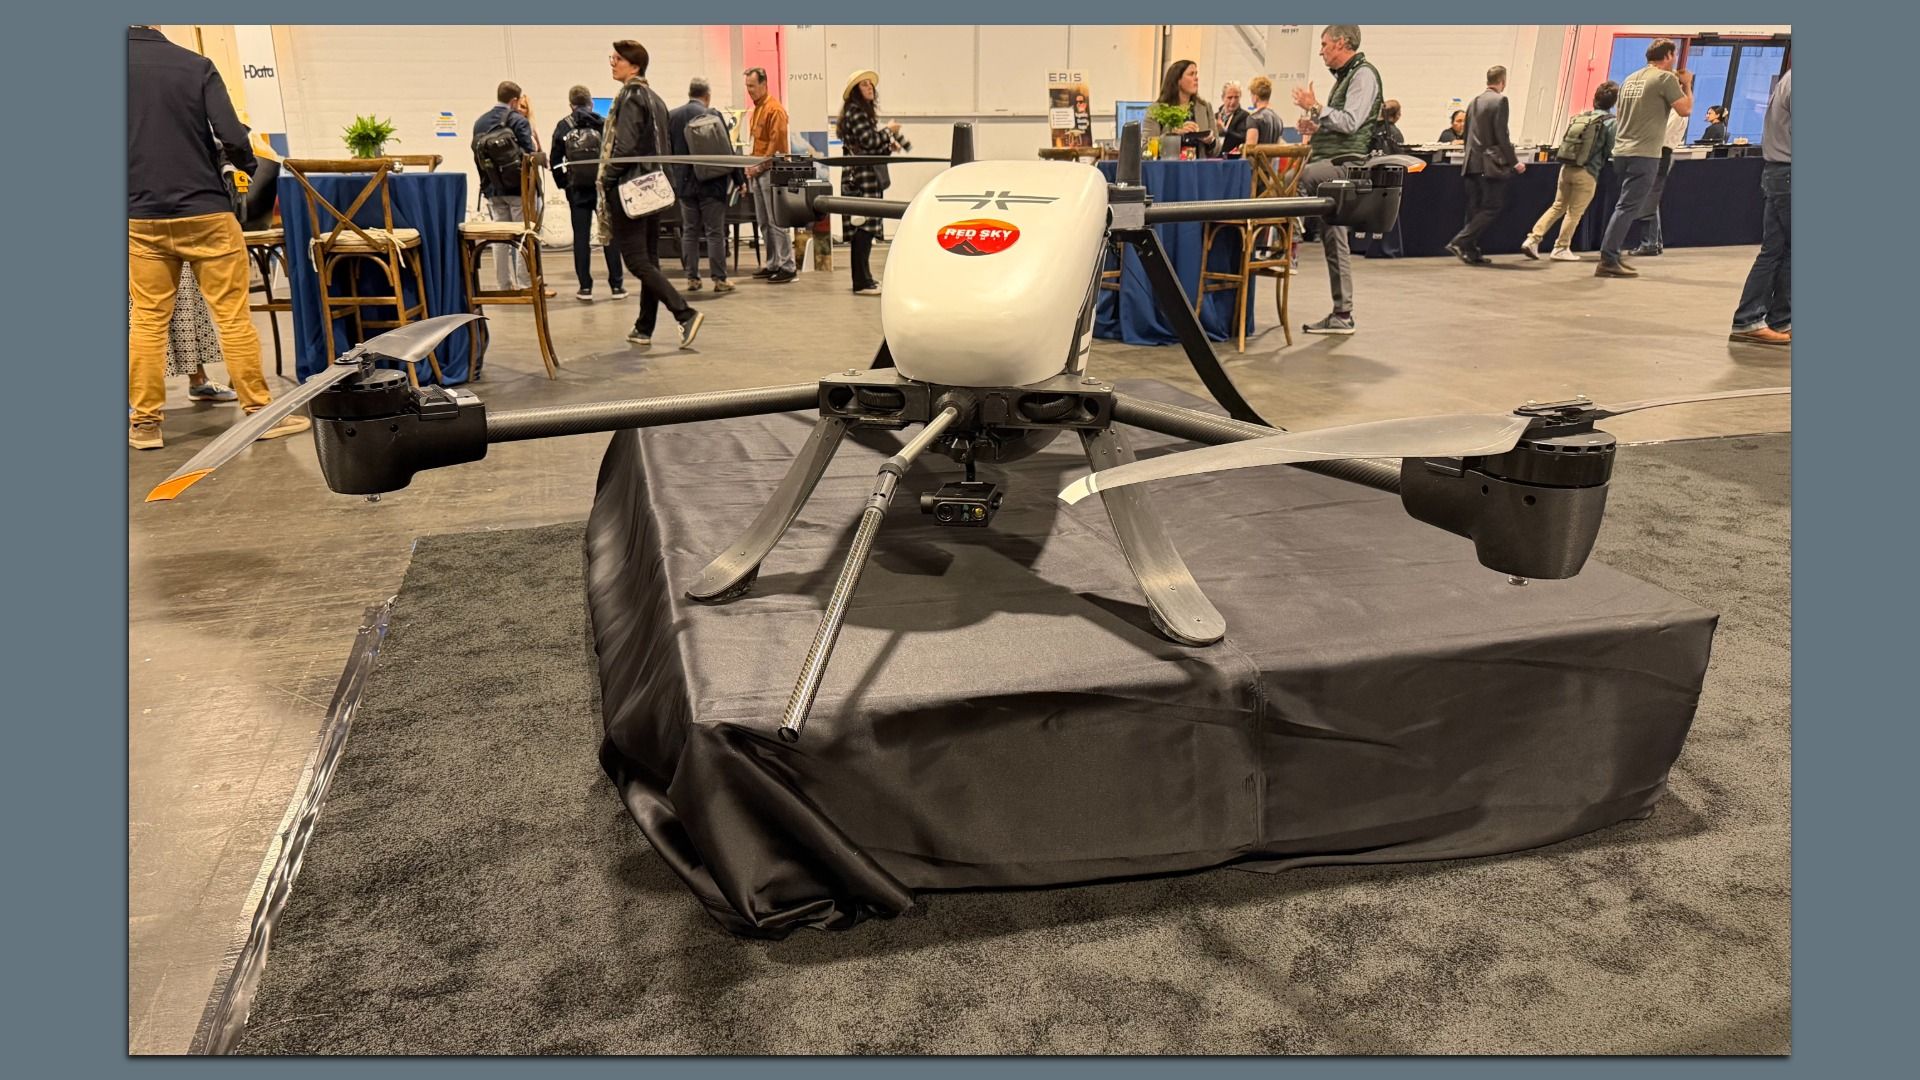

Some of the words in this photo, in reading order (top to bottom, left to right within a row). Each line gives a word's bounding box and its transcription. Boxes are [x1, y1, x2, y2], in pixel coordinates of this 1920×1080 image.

[243, 64, 275, 79] HData
[789, 73, 824, 81] PIVOTAL
[1048, 72, 1082, 82] ERIS
[945, 228, 977, 237] RED
[979, 229, 1013, 239] SKY
